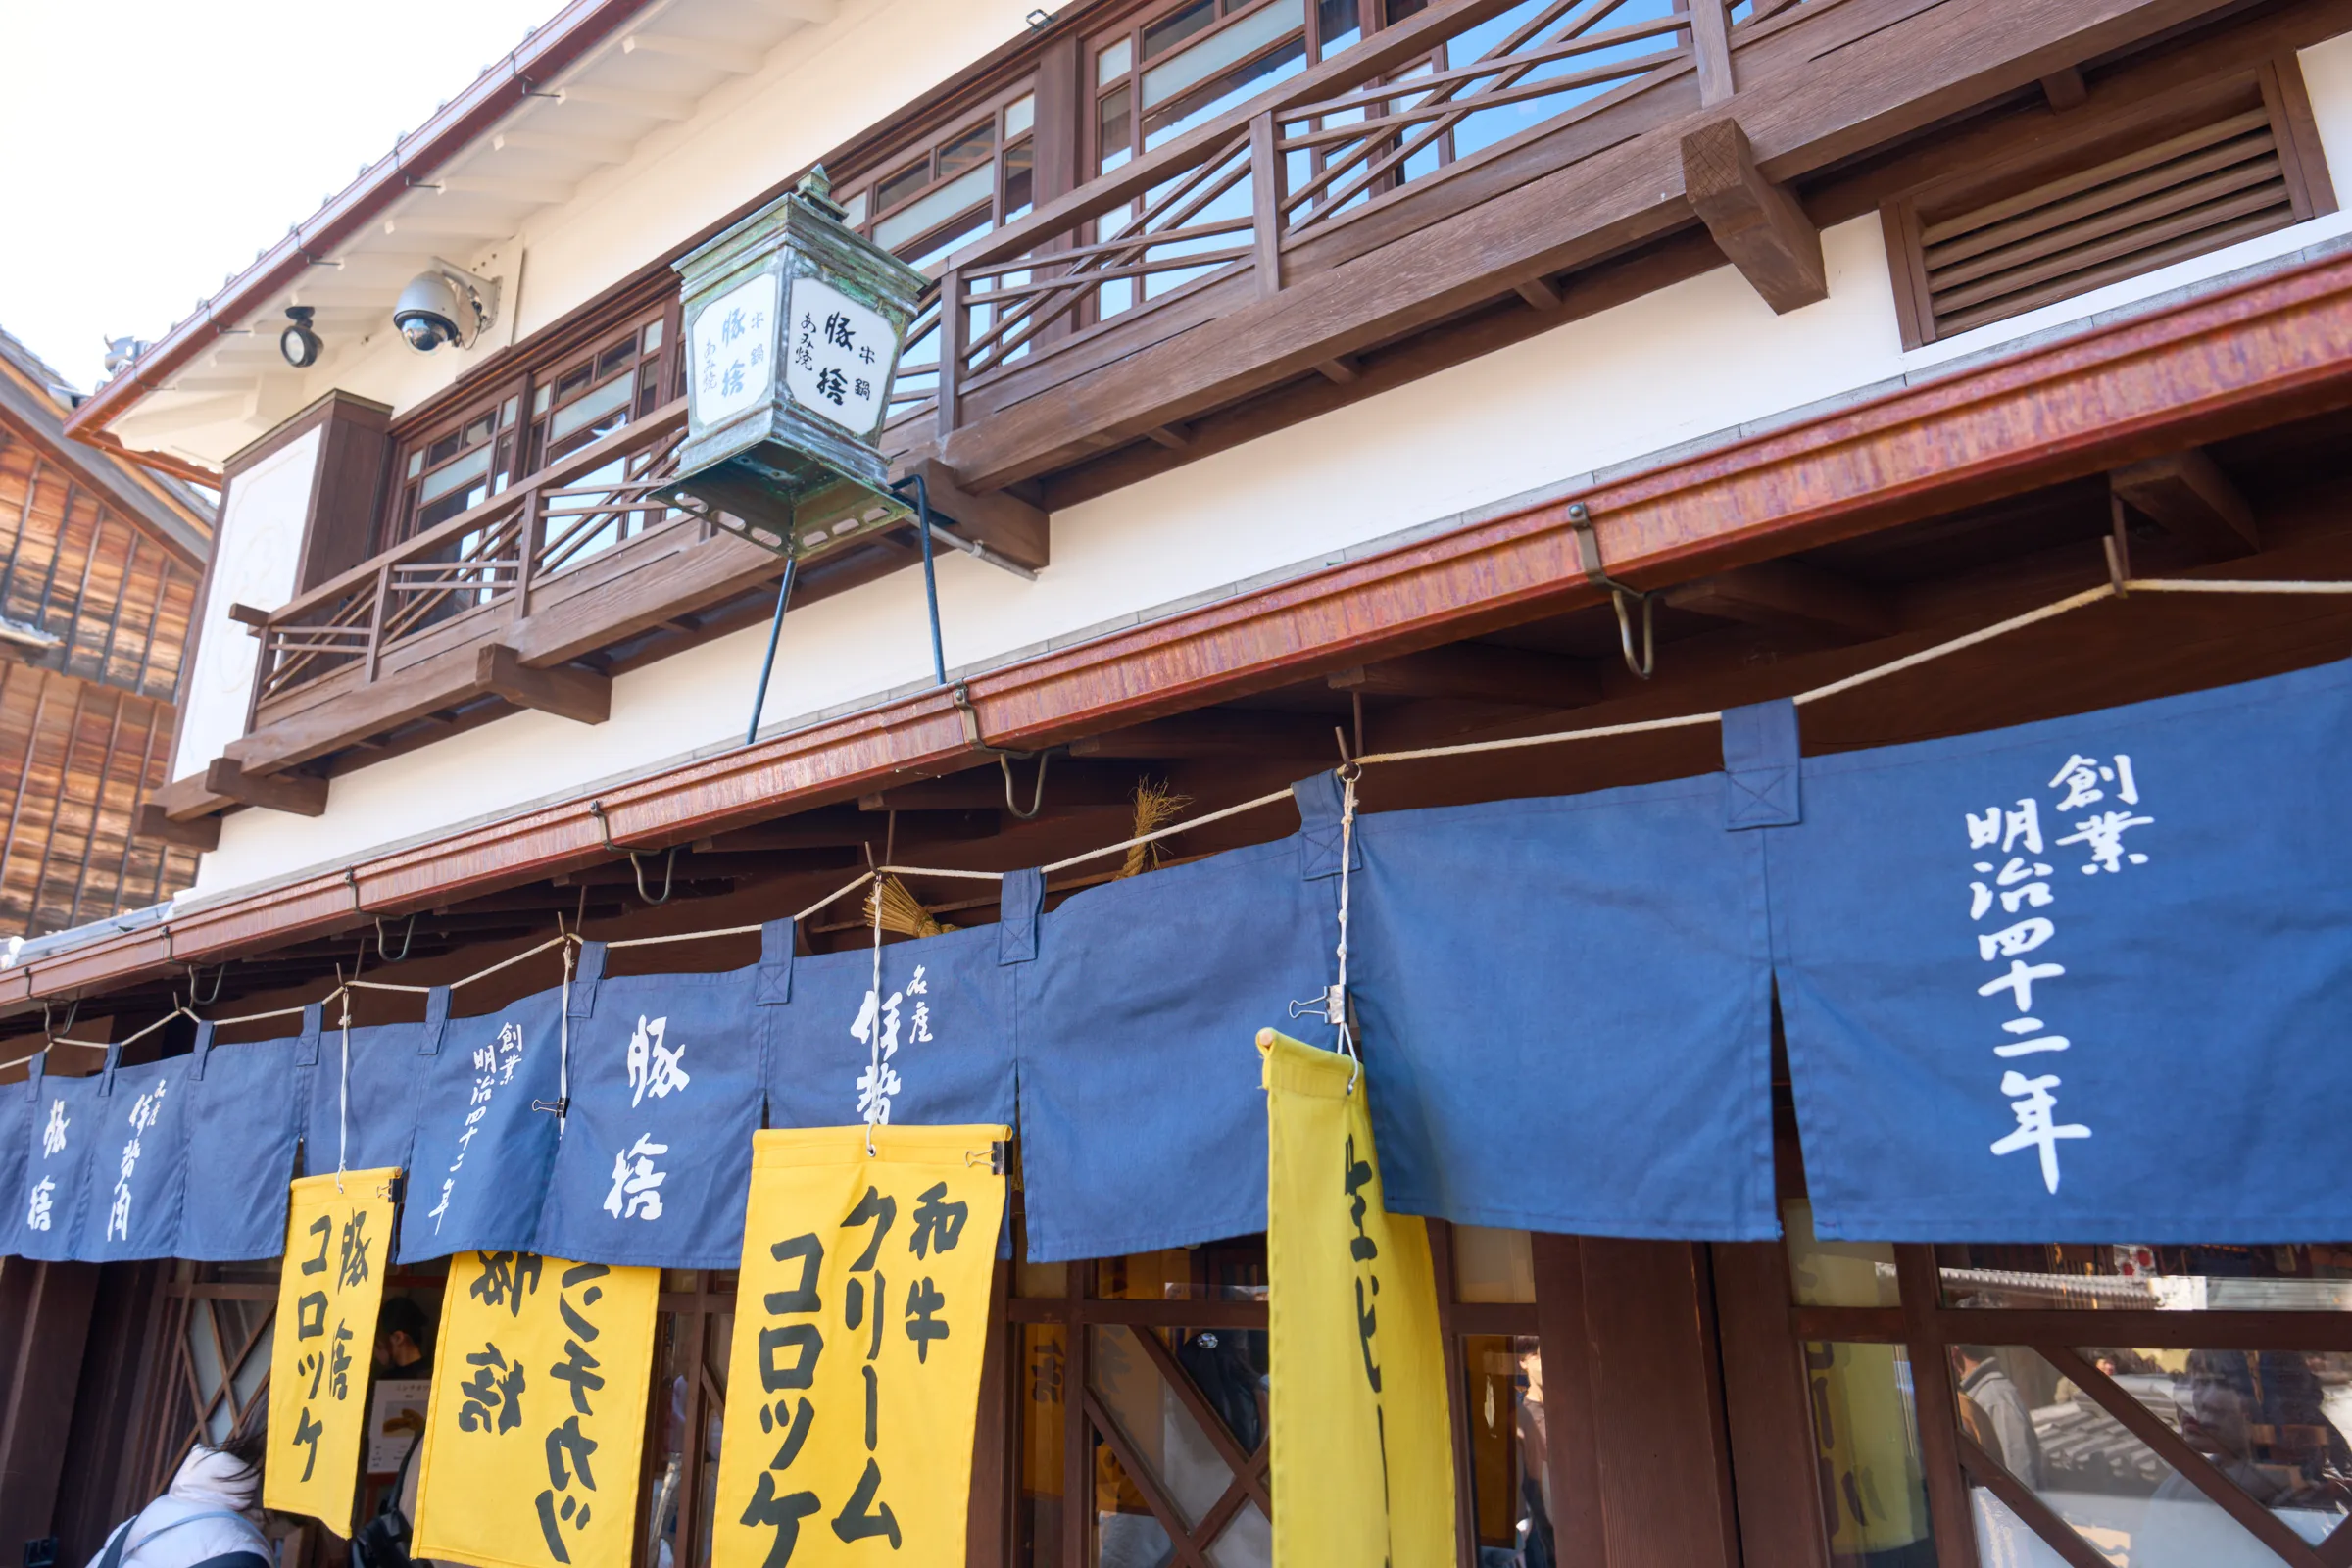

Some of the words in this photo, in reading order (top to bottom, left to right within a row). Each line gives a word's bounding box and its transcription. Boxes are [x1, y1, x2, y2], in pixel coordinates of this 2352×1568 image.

[816, 311, 857, 406] 豚捨
[855, 346, 875, 401] 牛鍋
[2048, 755, 2154, 875] 創業
[497, 1022, 522, 1085] 創業
[906, 965, 933, 1044] 名産
[1966, 798, 2091, 1194] 明治四十二年
[428, 1045, 497, 1236] 明治四十二年
[604, 1015, 690, 1220] 豚捨
[293, 1215, 332, 1483] コロッケ
[329, 1207, 372, 1400] 豚捨
[831, 1186, 903, 1549] クリーム
[906, 1182, 968, 1364] 和牛
[740, 1233, 824, 1568] コロッケ
